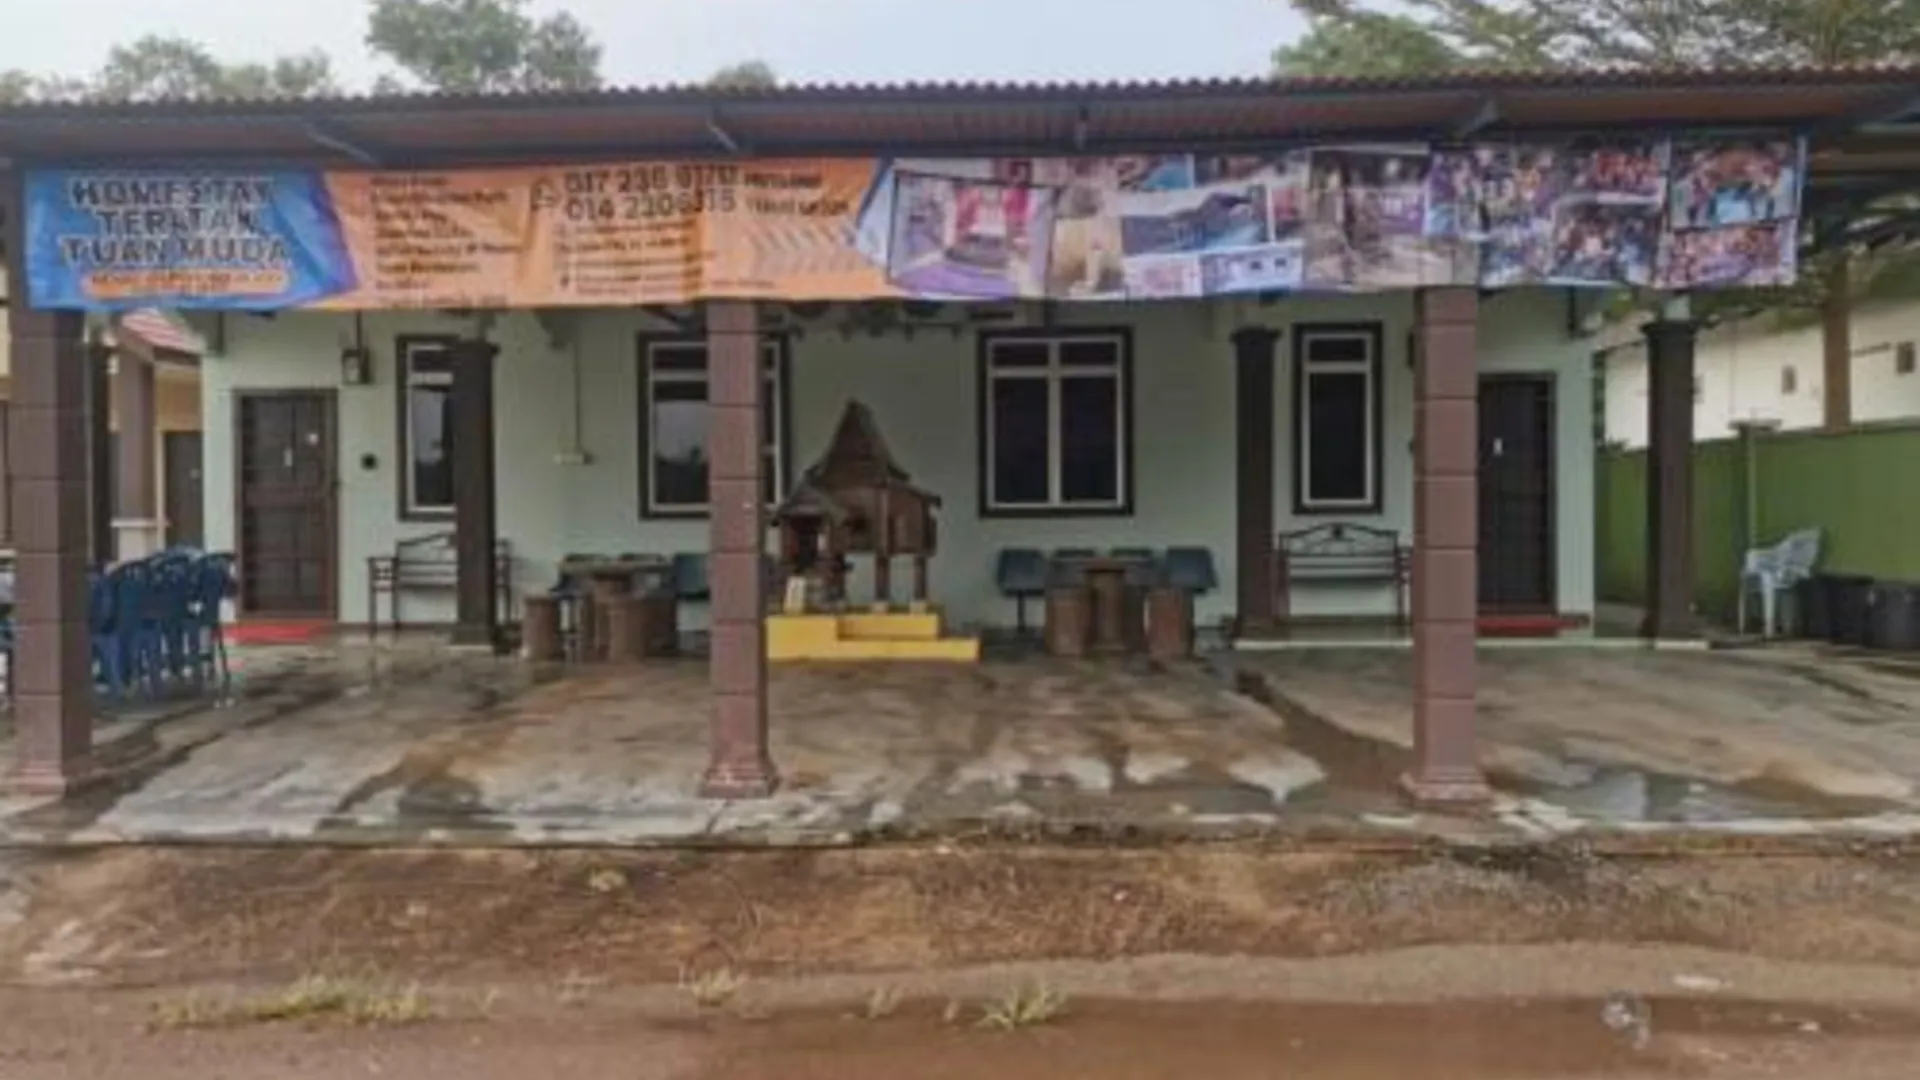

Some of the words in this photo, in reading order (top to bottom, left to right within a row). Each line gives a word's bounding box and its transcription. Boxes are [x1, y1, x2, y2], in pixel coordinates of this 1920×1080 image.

[69, 177, 274, 206] HOMESTAY
[61, 236, 168, 264] TUAN
[178, 234, 289, 263] MUDA
